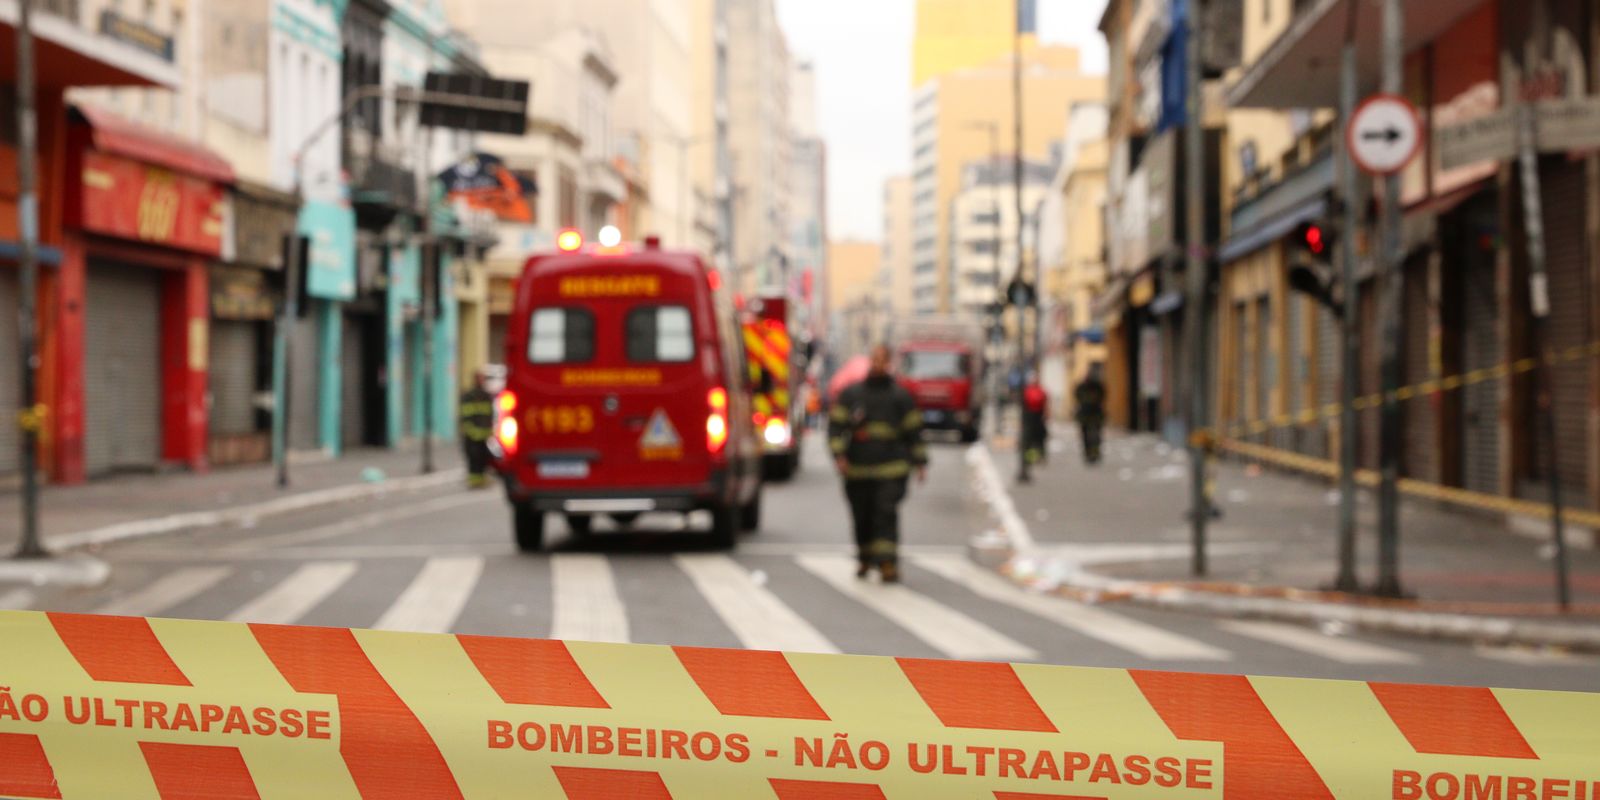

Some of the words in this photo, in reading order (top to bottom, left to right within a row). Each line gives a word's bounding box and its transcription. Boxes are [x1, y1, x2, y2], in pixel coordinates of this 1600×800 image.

[64, 696, 331, 739] ULTRAPASSE
[488, 720, 749, 762] BOMBEIROS
[795, 733, 889, 770] NÃO
[908, 744, 1212, 788] ULTRAPASSE
[1393, 770, 1600, 800] BOMBEI
